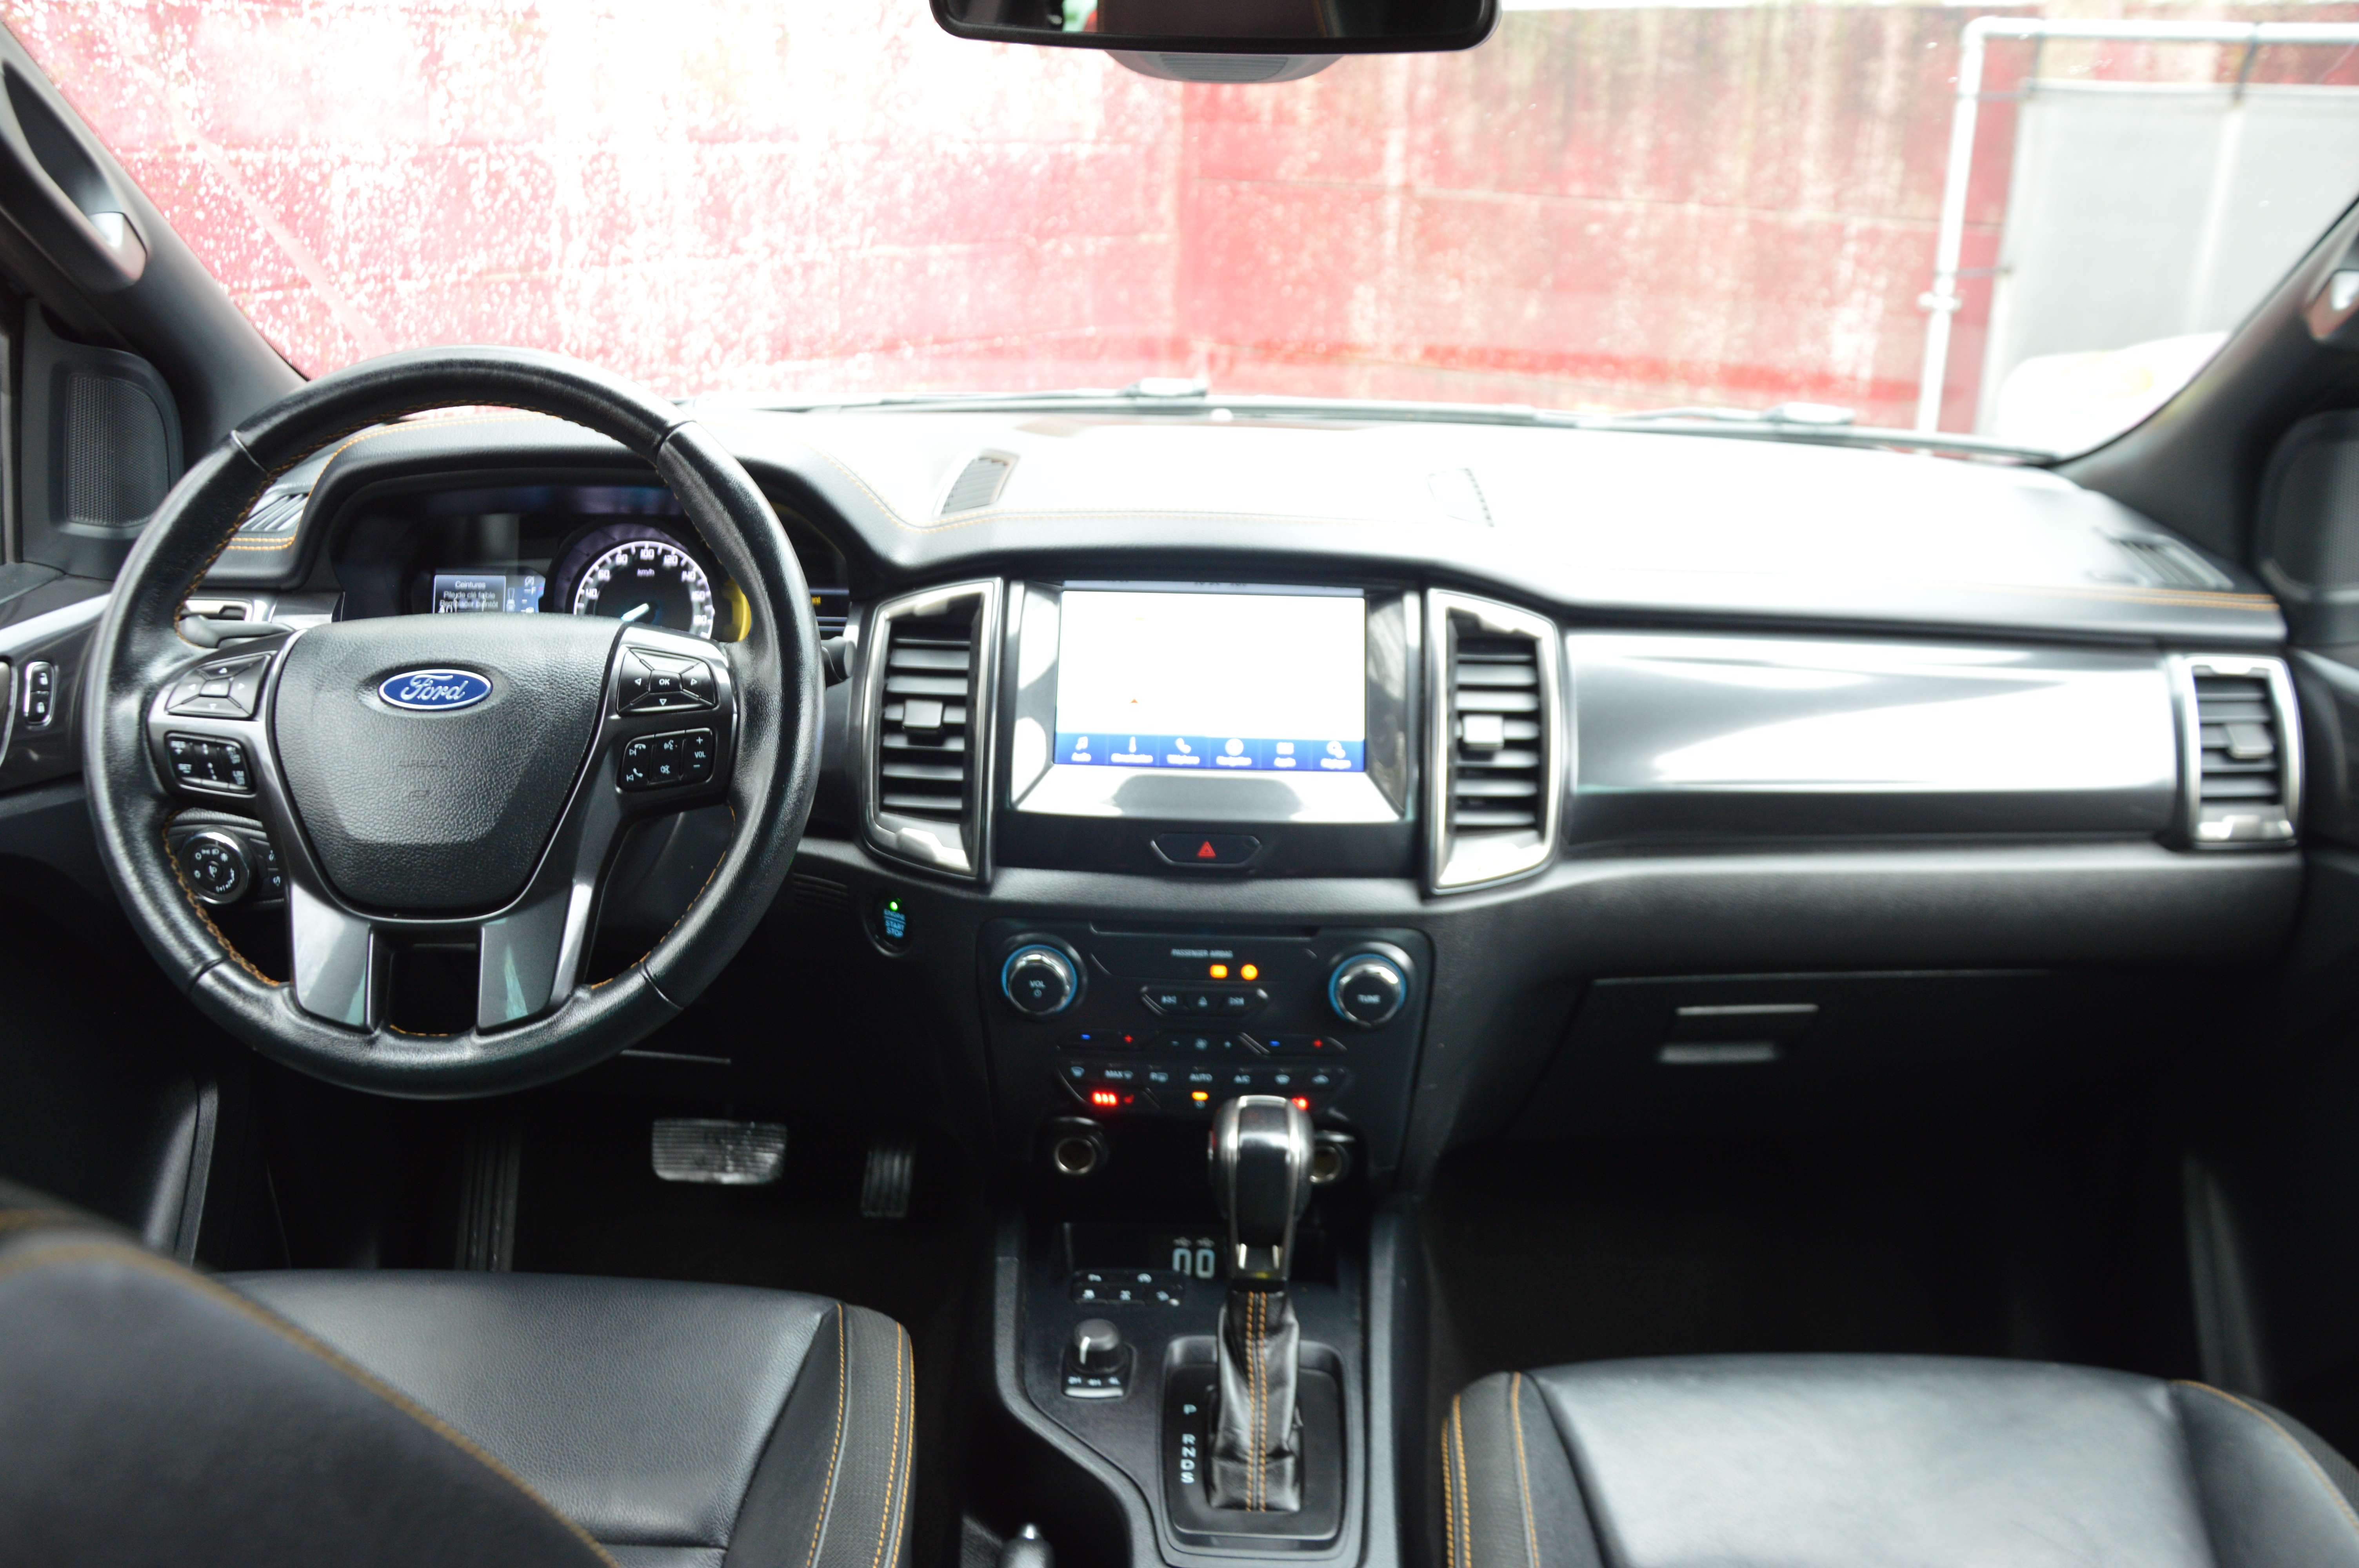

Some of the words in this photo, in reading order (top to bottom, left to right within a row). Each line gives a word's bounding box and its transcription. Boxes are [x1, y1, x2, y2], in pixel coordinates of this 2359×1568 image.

[615, 554, 628, 566] 80
[640, 549, 654, 561] 100
[663, 555, 678, 566] 120
[598, 570, 610, 581] 60
[637, 568, 655, 577] km/h
[682, 571, 696, 582] 140
[455, 581, 486, 589] Ceintures
[585, 588, 598, 599] 40
[691, 591, 705, 602] 160
[400, 674, 469, 701] Ford
[885, 920, 905, 932] START
[887, 927, 903, 938] STOP
[1029, 980, 1046, 988] VOL
[1357, 995, 1380, 1003] TUNE
[1189, 1073, 1212, 1082] AUTO
[1183, 1404, 1197, 1415] P
[1182, 1433, 1196, 1445] R
[1181, 1446, 1196, 1458] N
[1180, 1459, 1195, 1470] D
[1180, 1472, 1194, 1483] S
